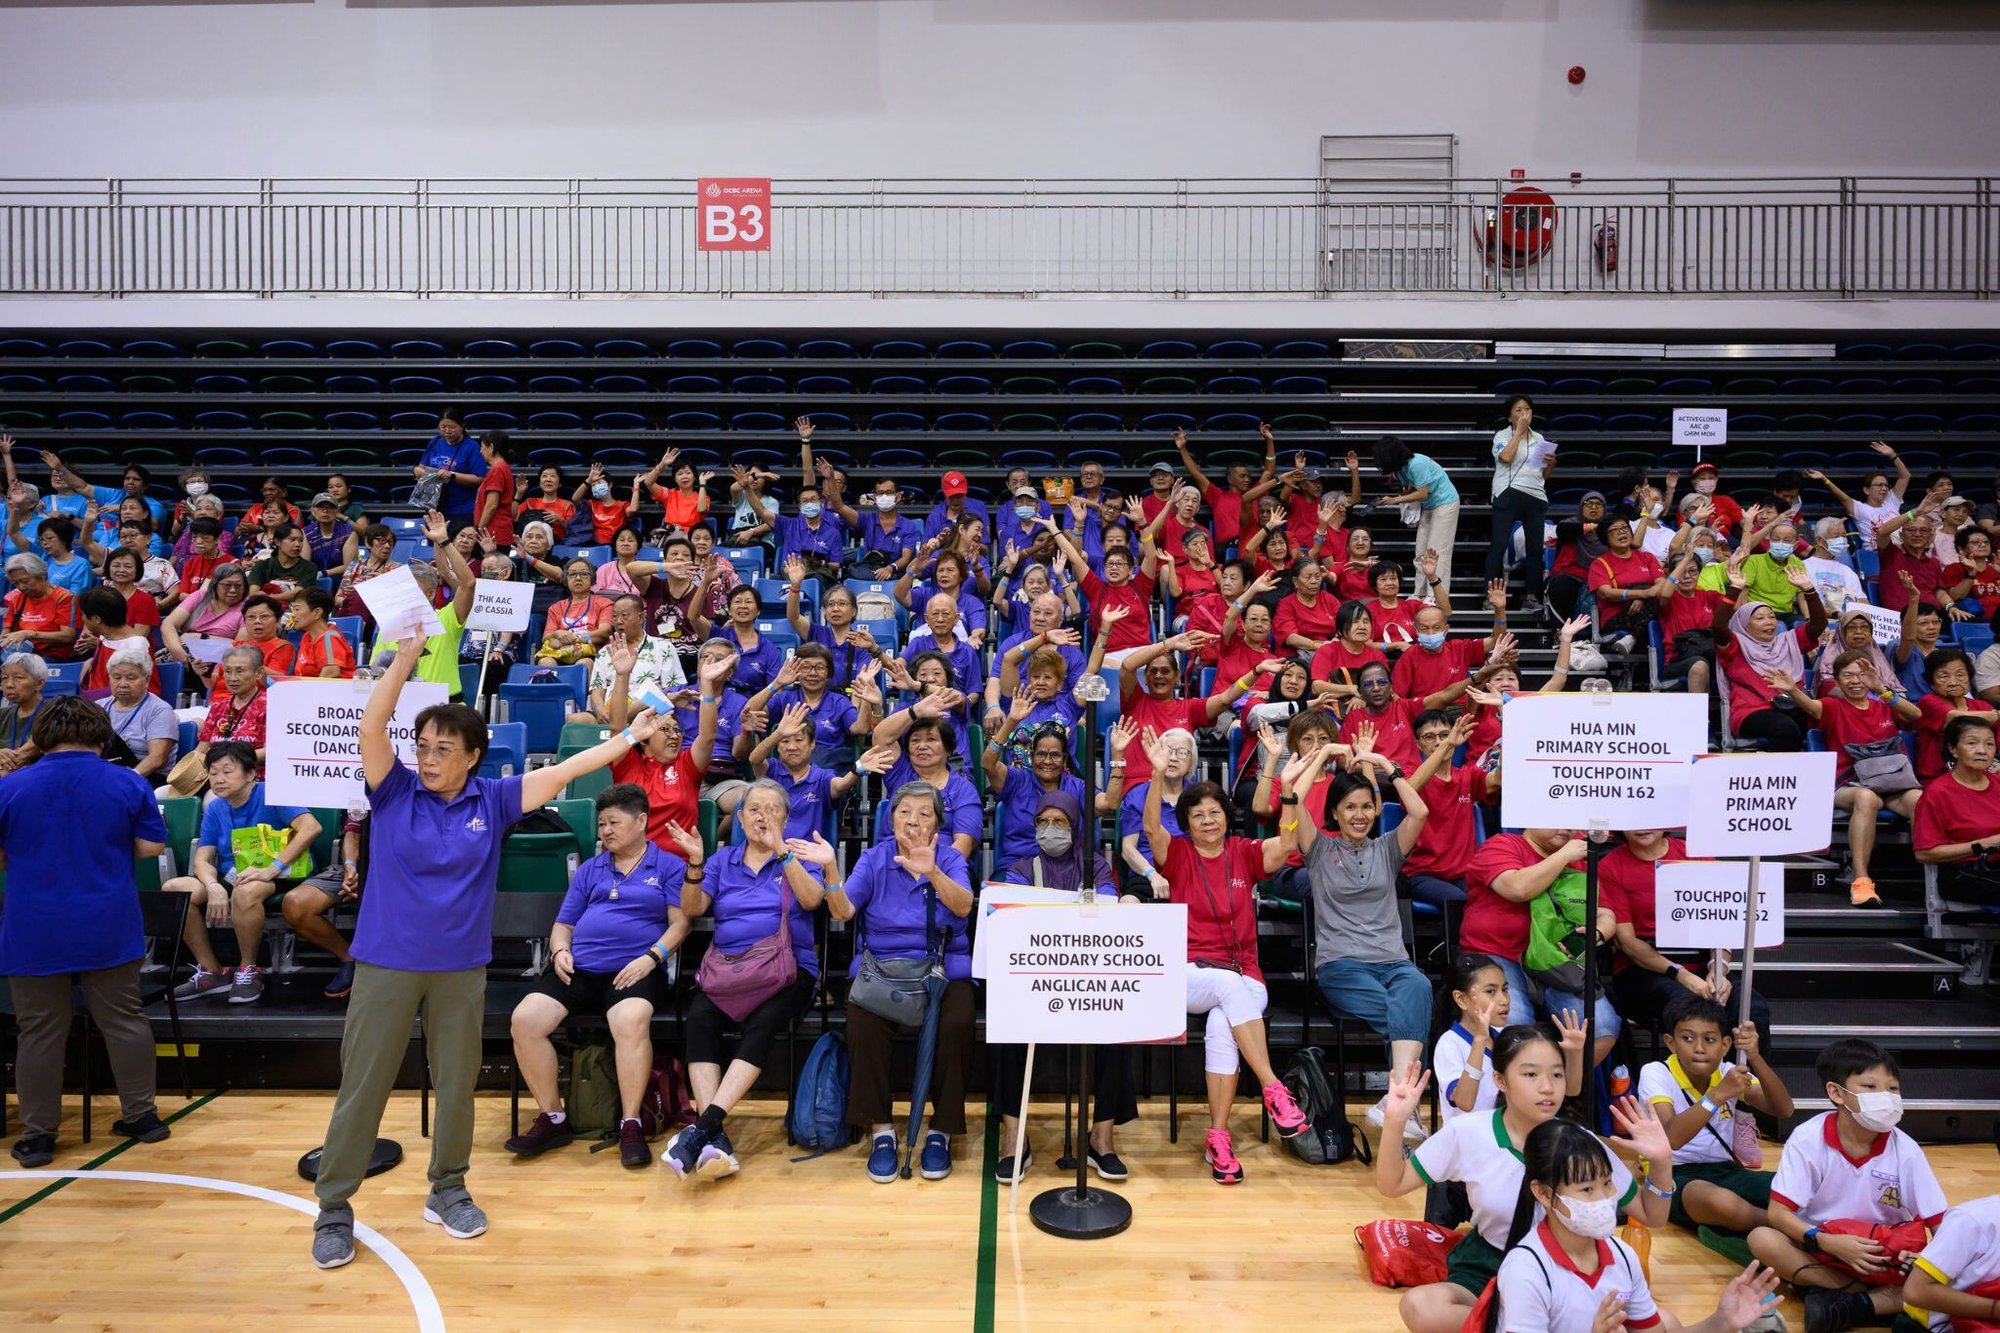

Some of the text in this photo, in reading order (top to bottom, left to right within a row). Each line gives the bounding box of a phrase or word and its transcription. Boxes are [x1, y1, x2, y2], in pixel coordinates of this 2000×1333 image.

[706, 204, 764, 242] B3
[478, 594, 494, 602] THK
[474, 605, 513, 616] @ CASSIA
[286, 722, 360, 738] SECONDAR
[1570, 722, 1636, 736] HUA MIN
[1536, 740, 1670, 755] PRIMARY SCHOOL
[293, 764, 366, 782] THK AAC @
[1552, 766, 1652, 780] TOUCHPOINT
[1729, 776, 1797, 790] HUA MIN
[1548, 784, 1655, 798] @YISHUN 162
[1726, 796, 1798, 811] PRIMARY
[1728, 818, 1792, 832] SCHOOL
[1816, 874, 1826, 886] B
[1674, 890, 1766, 904] TOUCHPOIT
[1671, 908, 1738, 922] @YISHUN
[1030, 934, 1144, 948] NORTHBROOKS
[1009, 953, 1164, 966] SECONDARY SCHOOL
[1032, 979, 1140, 992] ANGLICAN AAC
[1937, 978, 1950, 990] A
[1048, 998, 1124, 1012] @ YISHUN
